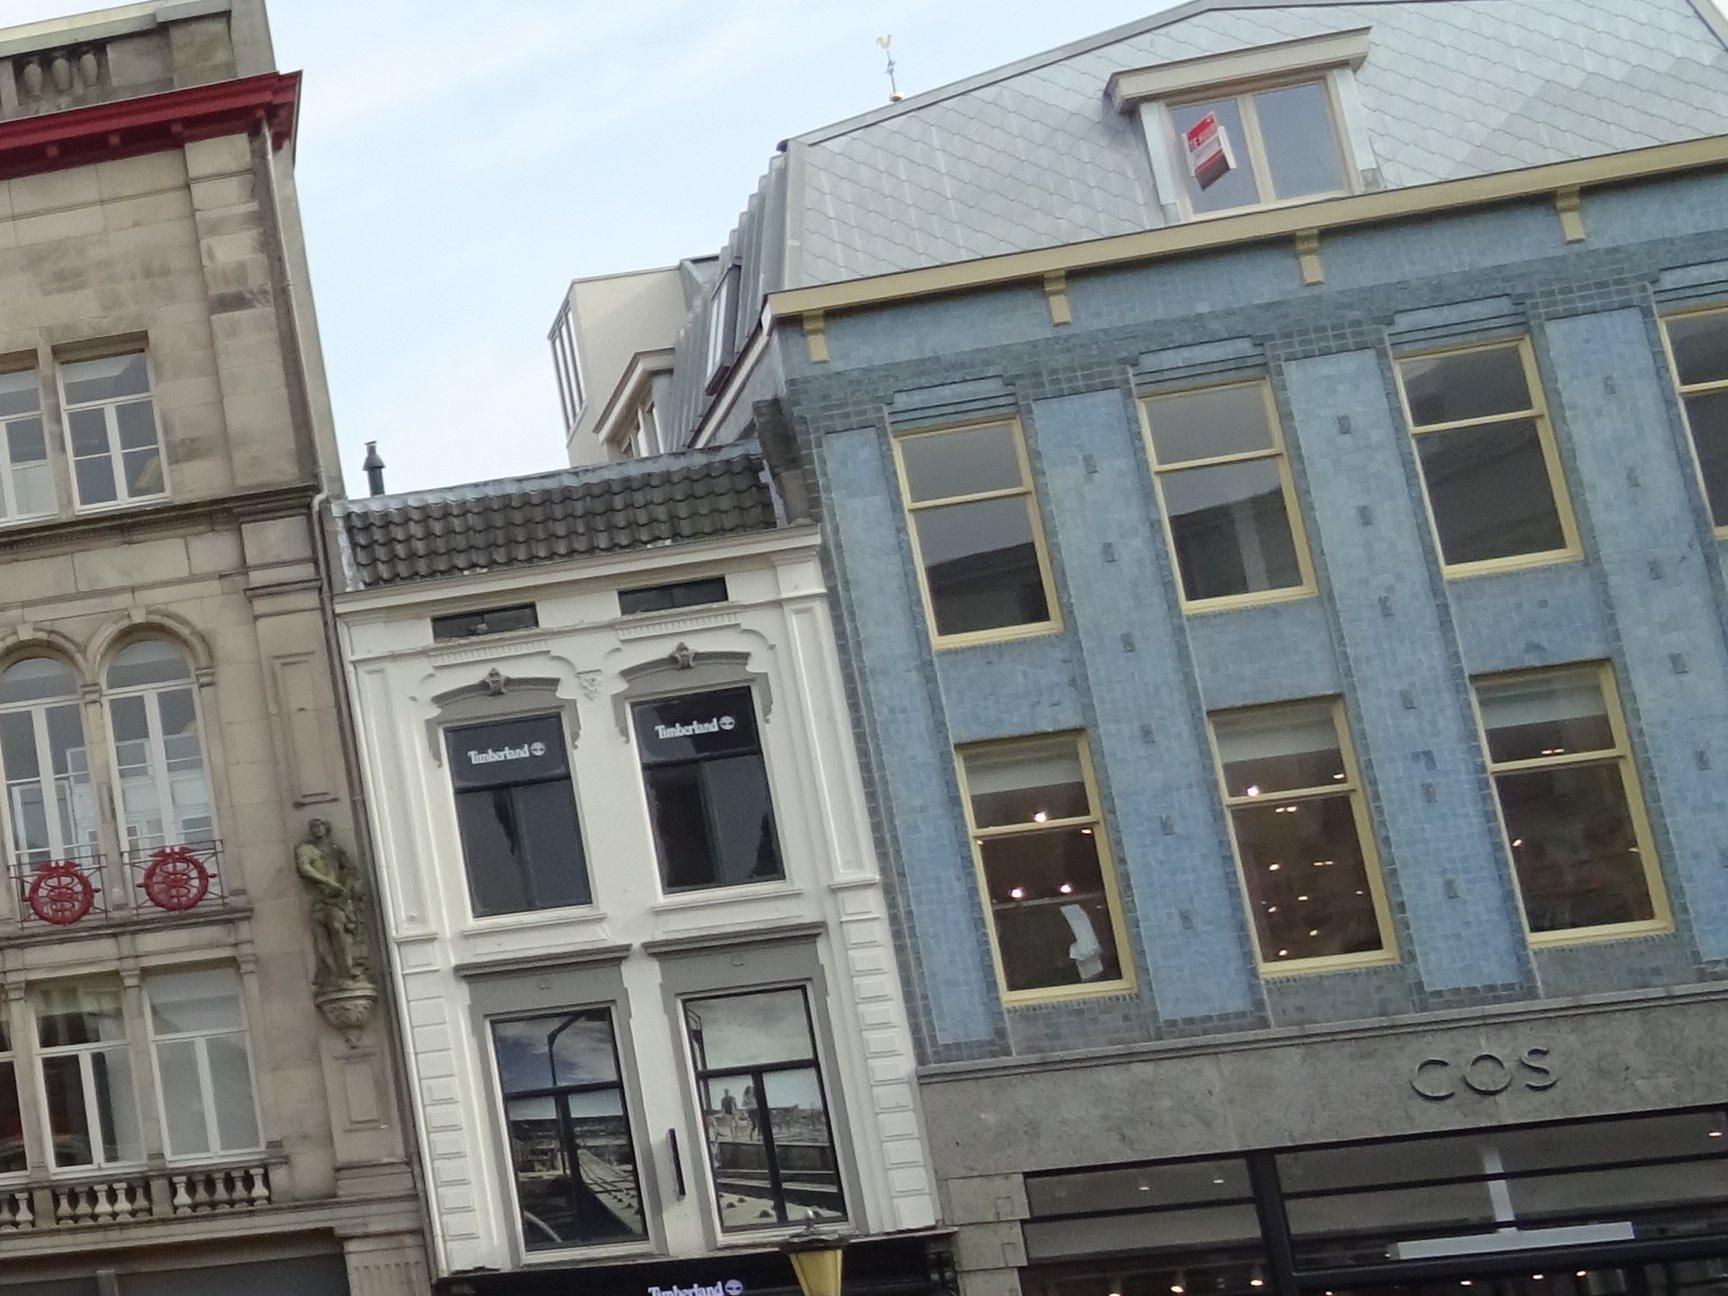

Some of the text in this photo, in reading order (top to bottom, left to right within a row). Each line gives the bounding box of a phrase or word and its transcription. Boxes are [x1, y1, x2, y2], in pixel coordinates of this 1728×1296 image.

[654, 717, 719, 740] Timberland
[467, 743, 530, 765] Timberland
[1409, 1047, 1559, 1102] COS
